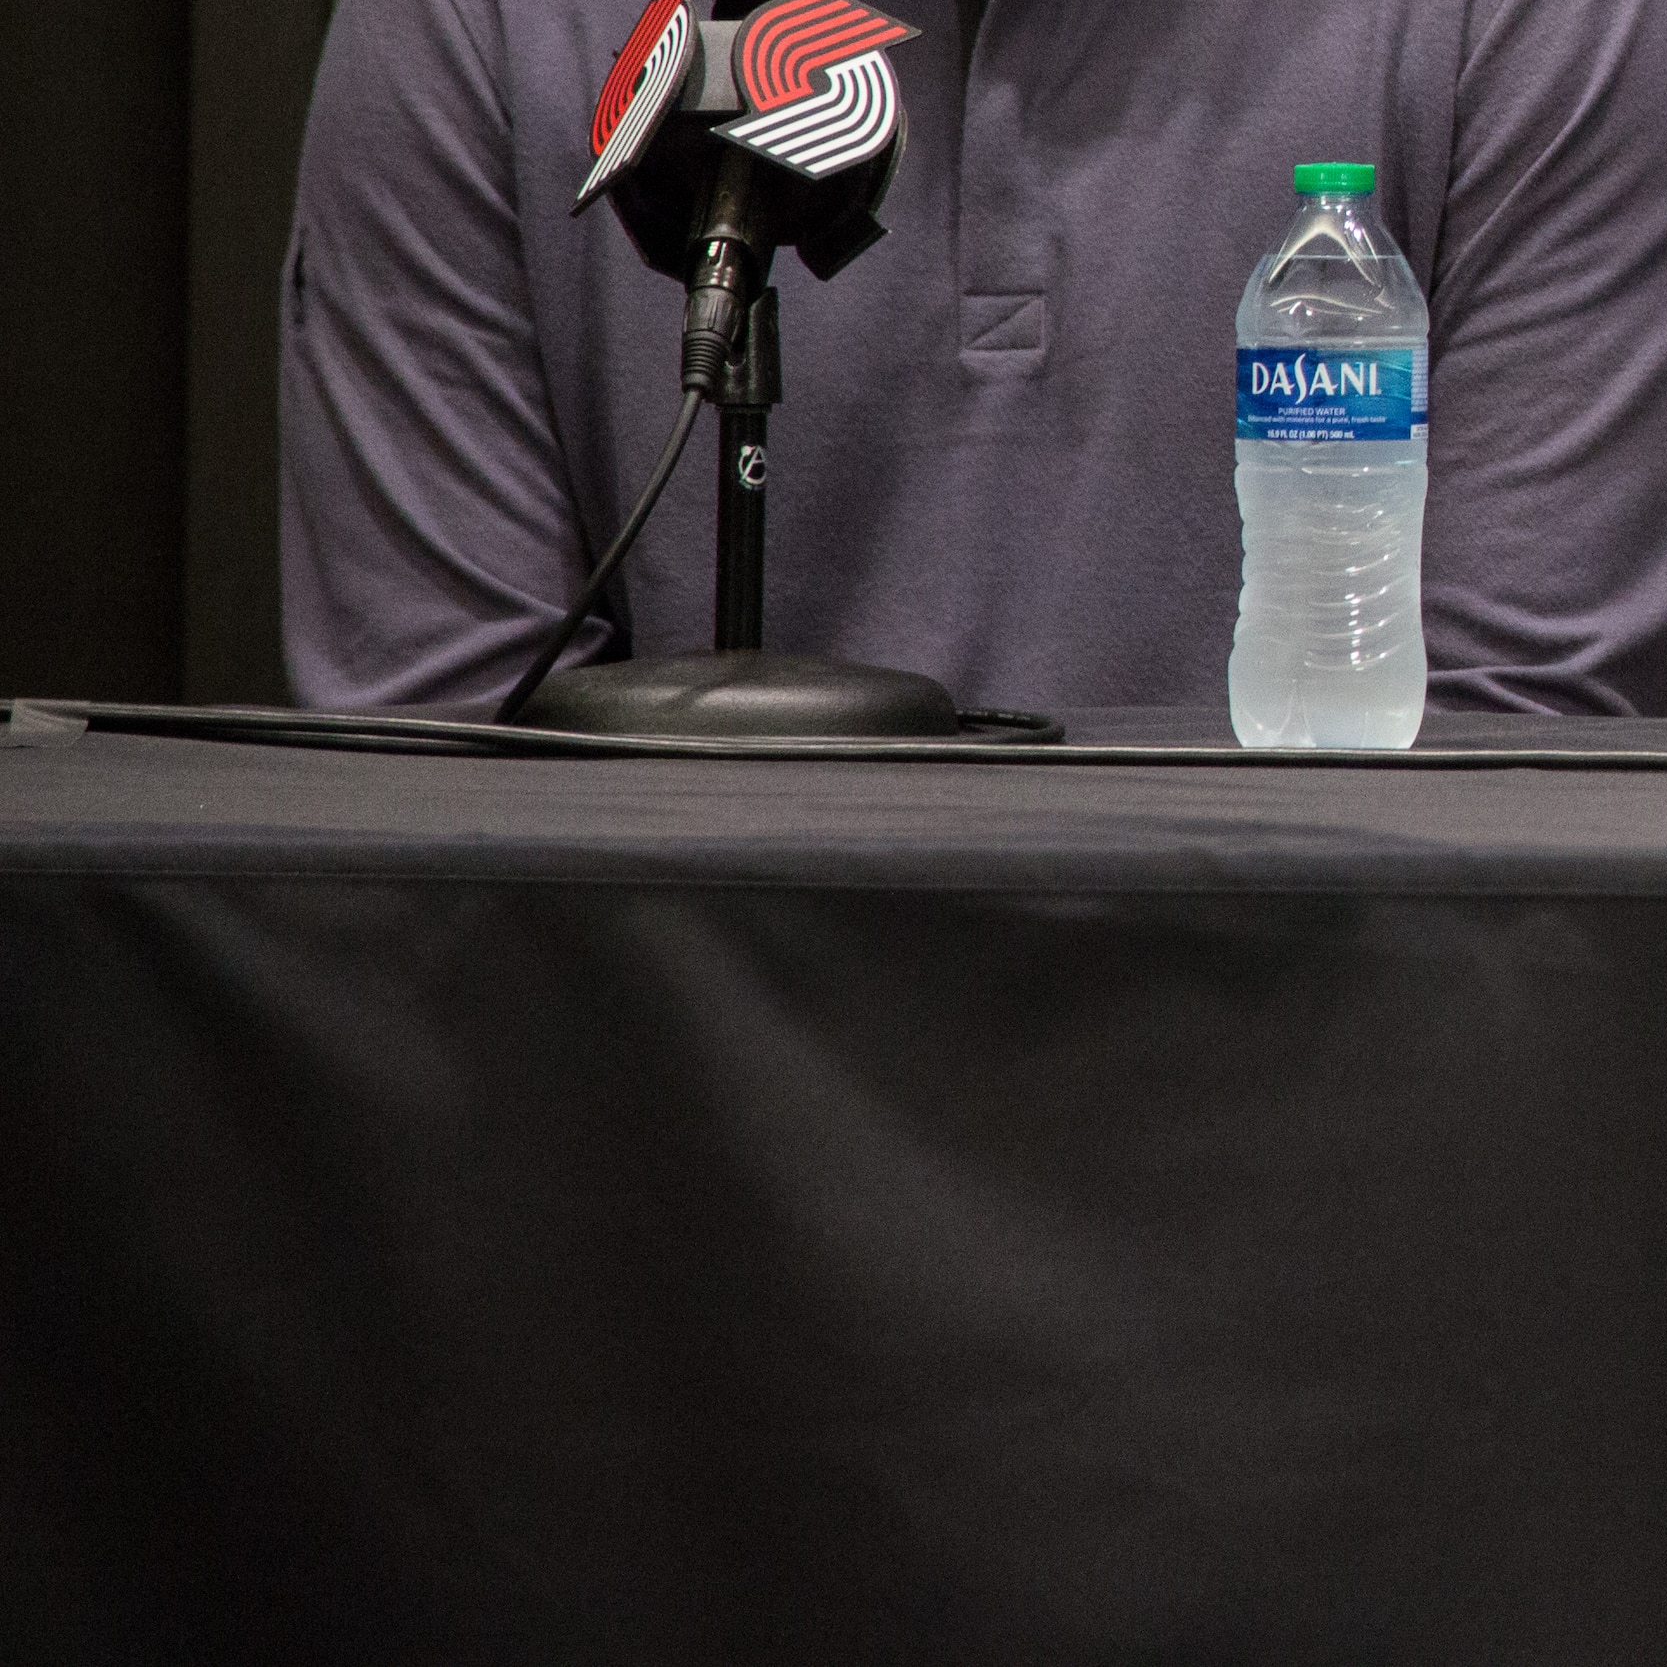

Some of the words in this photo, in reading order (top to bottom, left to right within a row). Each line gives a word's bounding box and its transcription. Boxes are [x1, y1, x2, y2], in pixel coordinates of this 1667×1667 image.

[1251, 352, 1378, 405] DASANI
[1278, 407, 1314, 416] PURIFIED
[1315, 407, 1346, 416] WATER
